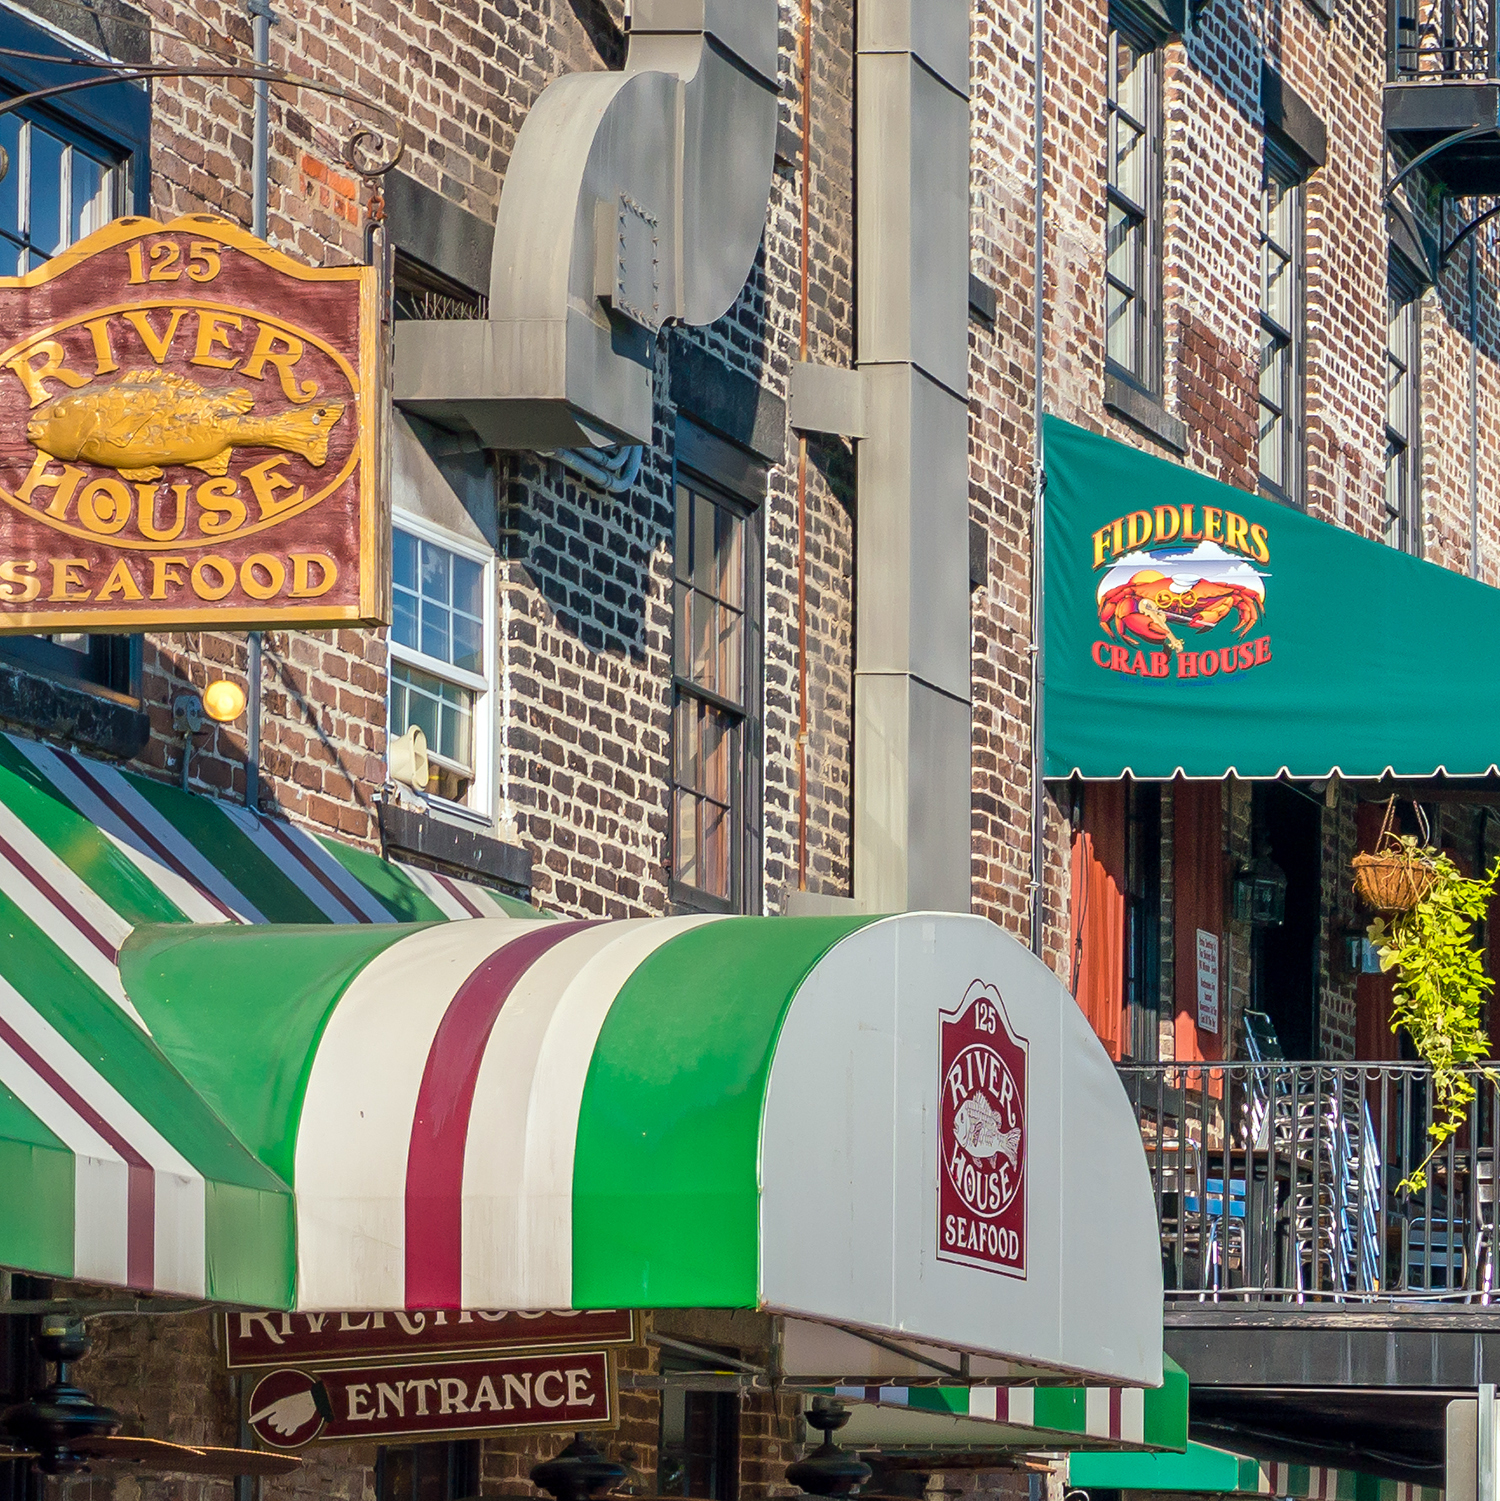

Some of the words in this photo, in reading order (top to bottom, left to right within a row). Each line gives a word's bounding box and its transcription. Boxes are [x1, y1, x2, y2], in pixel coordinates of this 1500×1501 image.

[126, 241, 222, 284] 125
[6, 308, 319, 409] RIVER
[13, 448, 305, 541] HOUSE
[1091, 503, 1270, 570] FIDDLERS
[0, 552, 338, 602] SEAFOOD
[1091, 639, 1171, 679] CRAB
[1176, 635, 1272, 679] HOUSE
[974, 1001, 996, 1034] 125
[949, 1050, 1017, 1128] RIVER
[950, 1140, 1013, 1211] HOUSE
[945, 1213, 1020, 1261] SEAFOOD
[345, 1367, 596, 1421] ENTRANCE
